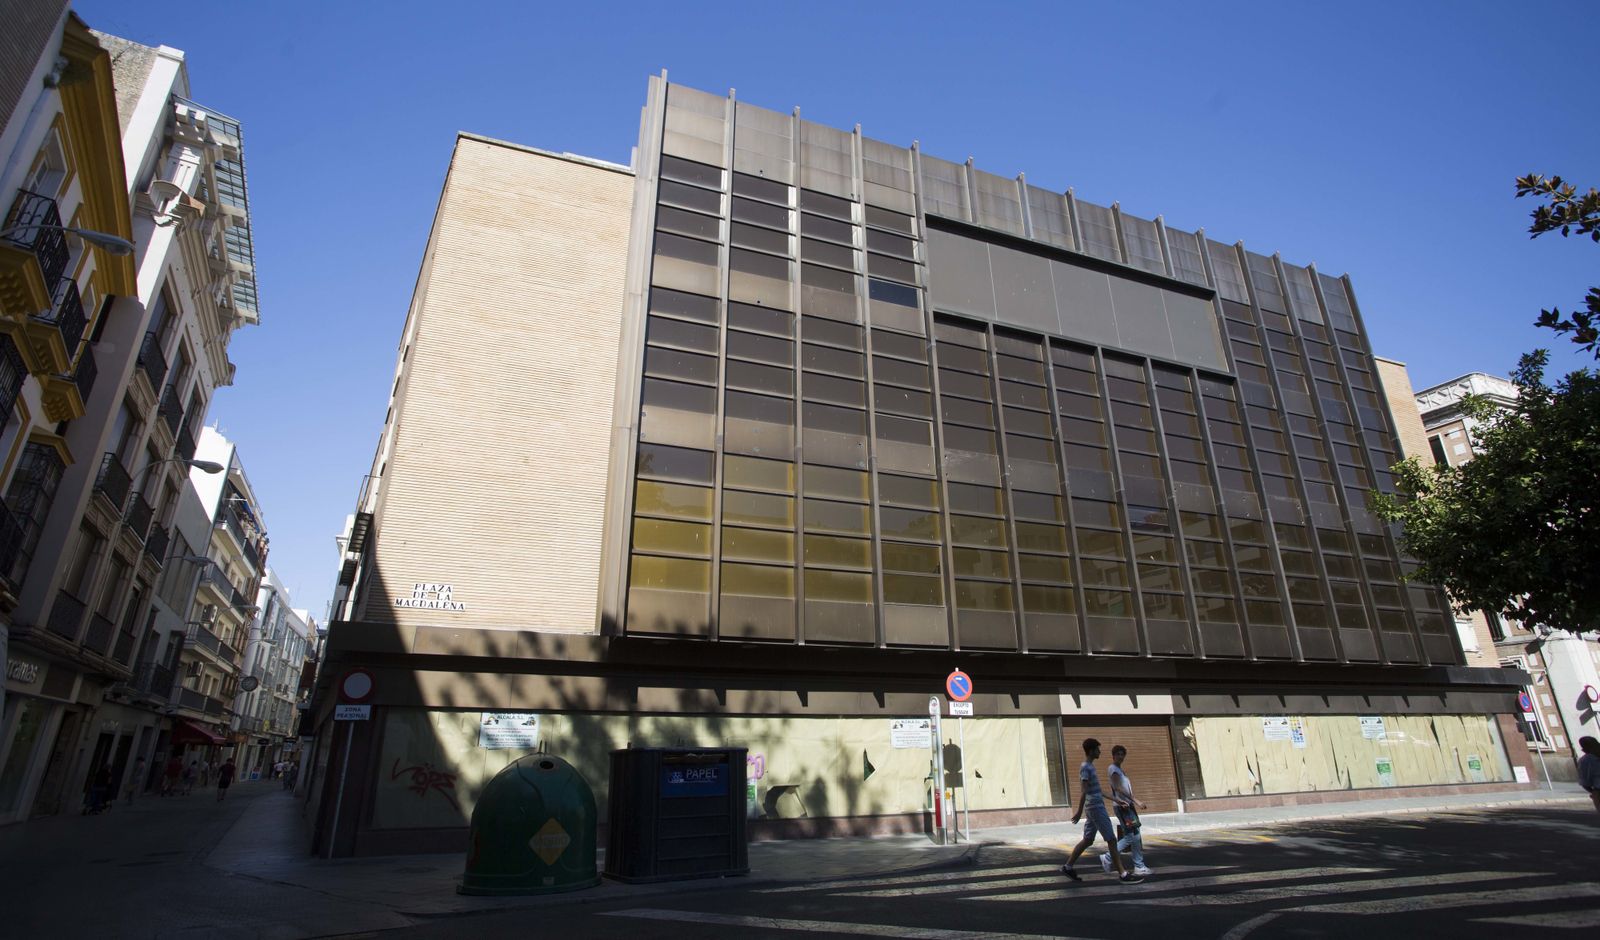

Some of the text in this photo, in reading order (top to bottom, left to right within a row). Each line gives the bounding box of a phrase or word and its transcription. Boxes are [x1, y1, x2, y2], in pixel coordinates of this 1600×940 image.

[414, 583, 452, 592] PLAZA
[413, 591, 450, 601] DE LA
[395, 598, 464, 610] MAGDALENA
[686, 768, 718, 779] PAPEL
